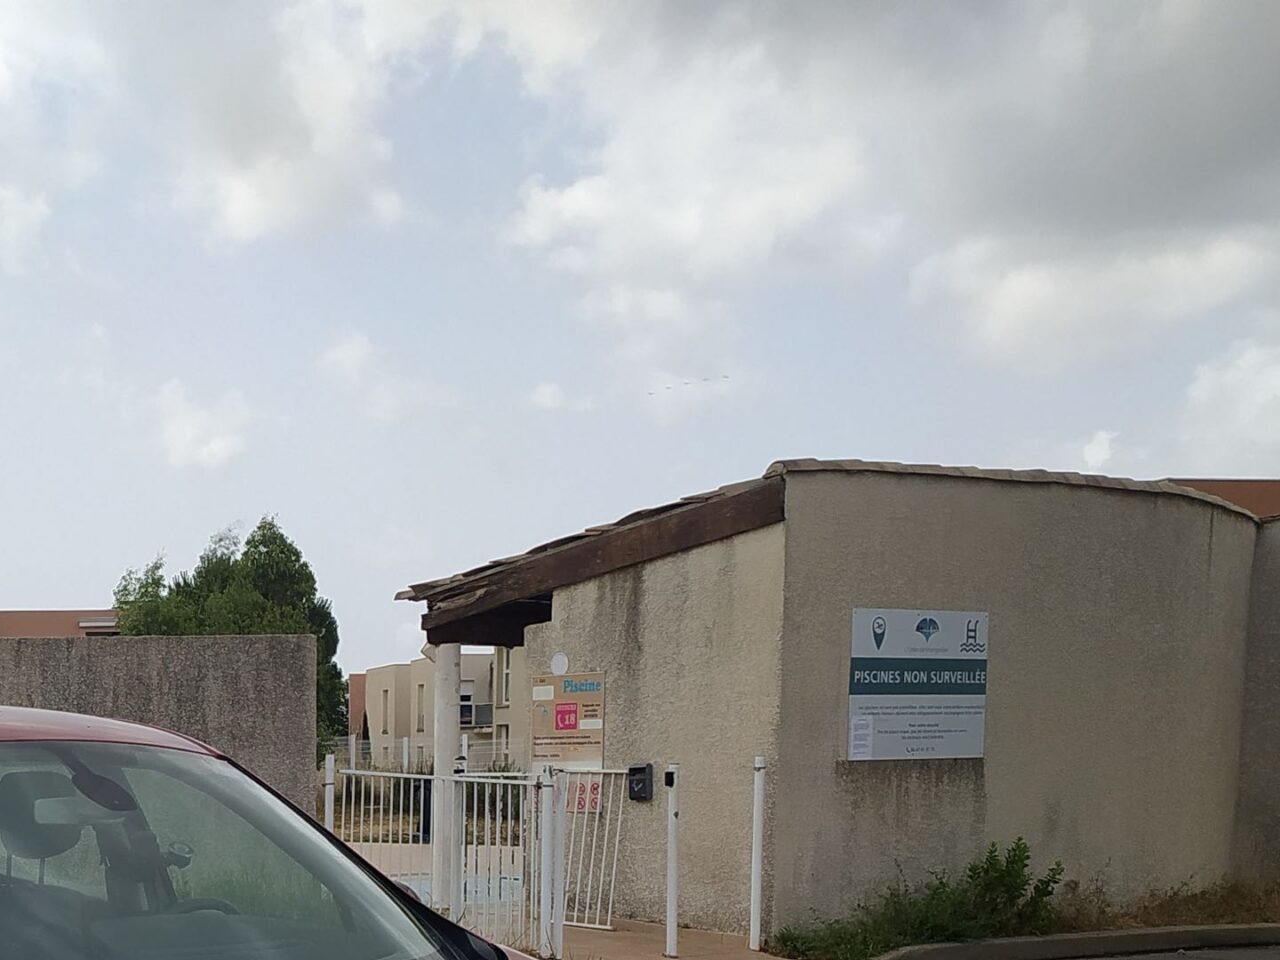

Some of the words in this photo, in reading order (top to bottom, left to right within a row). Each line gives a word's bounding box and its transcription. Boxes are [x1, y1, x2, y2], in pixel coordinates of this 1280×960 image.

[854, 670, 901, 684] PISCINES
[903, 670, 928, 684] NON
[563, 679, 601, 693] Piscine
[564, 713, 576, 725] 18
